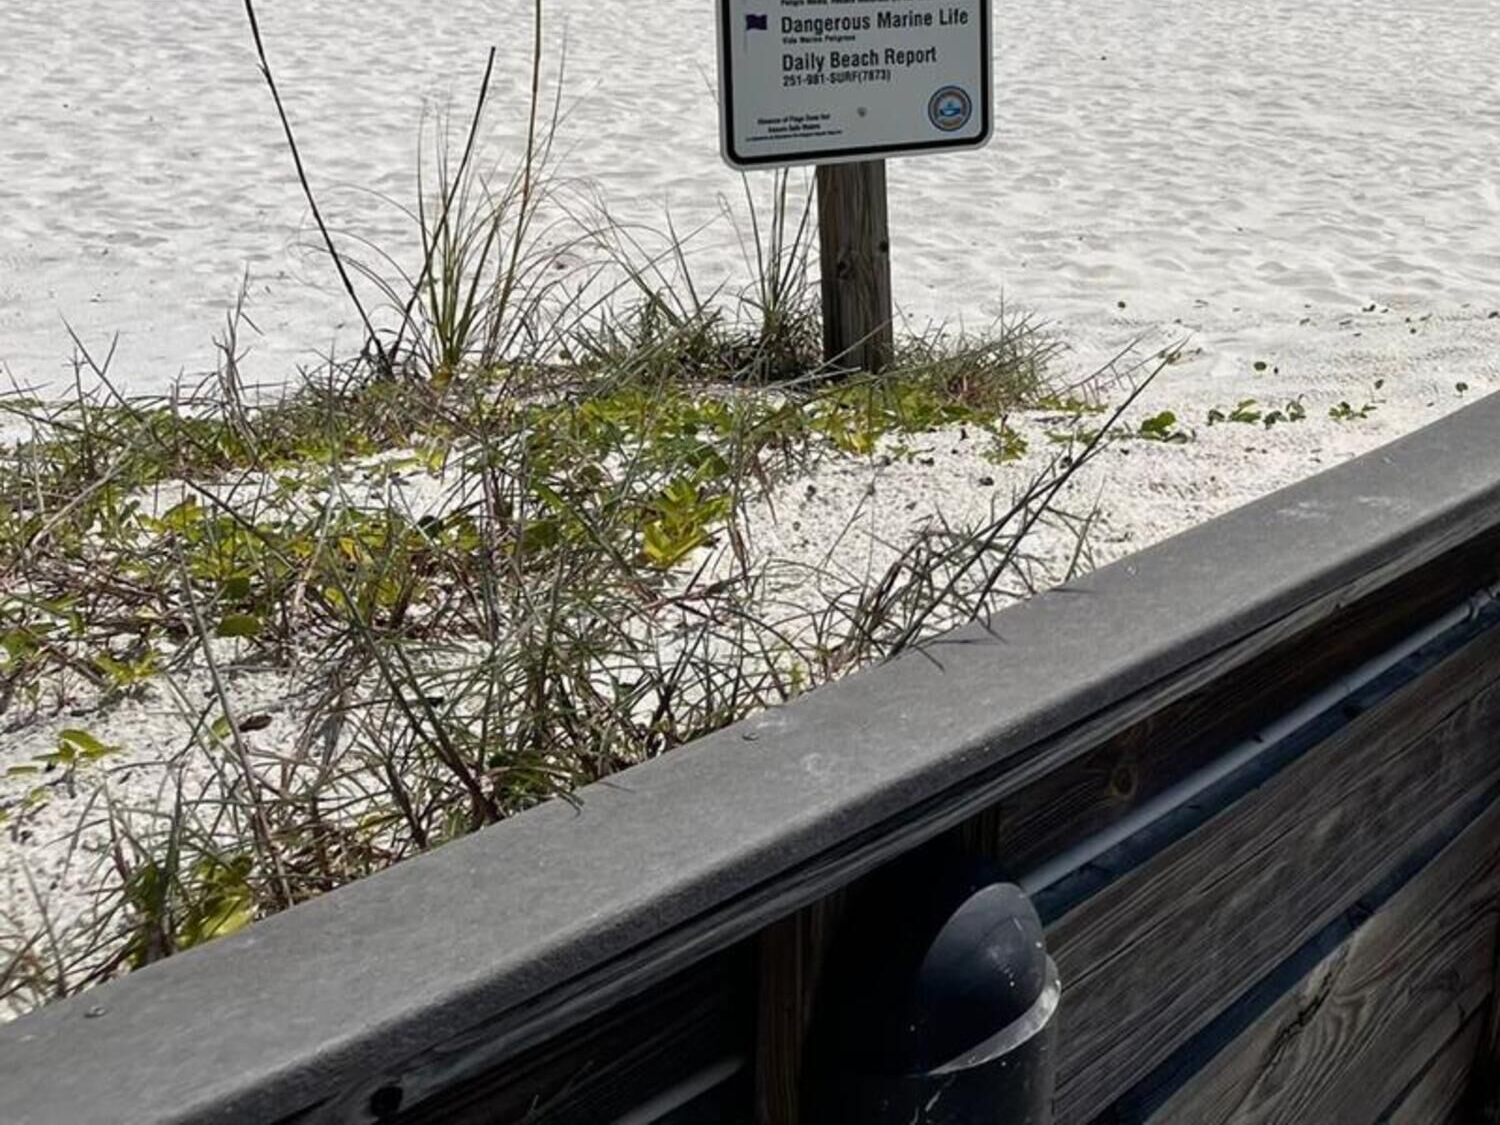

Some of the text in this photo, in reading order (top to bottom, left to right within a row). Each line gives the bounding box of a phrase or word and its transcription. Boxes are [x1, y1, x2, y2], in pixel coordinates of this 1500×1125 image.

[781, 8, 969, 36] Dangerous Marine Life
[783, 46, 937, 73] Daily Beach Report
